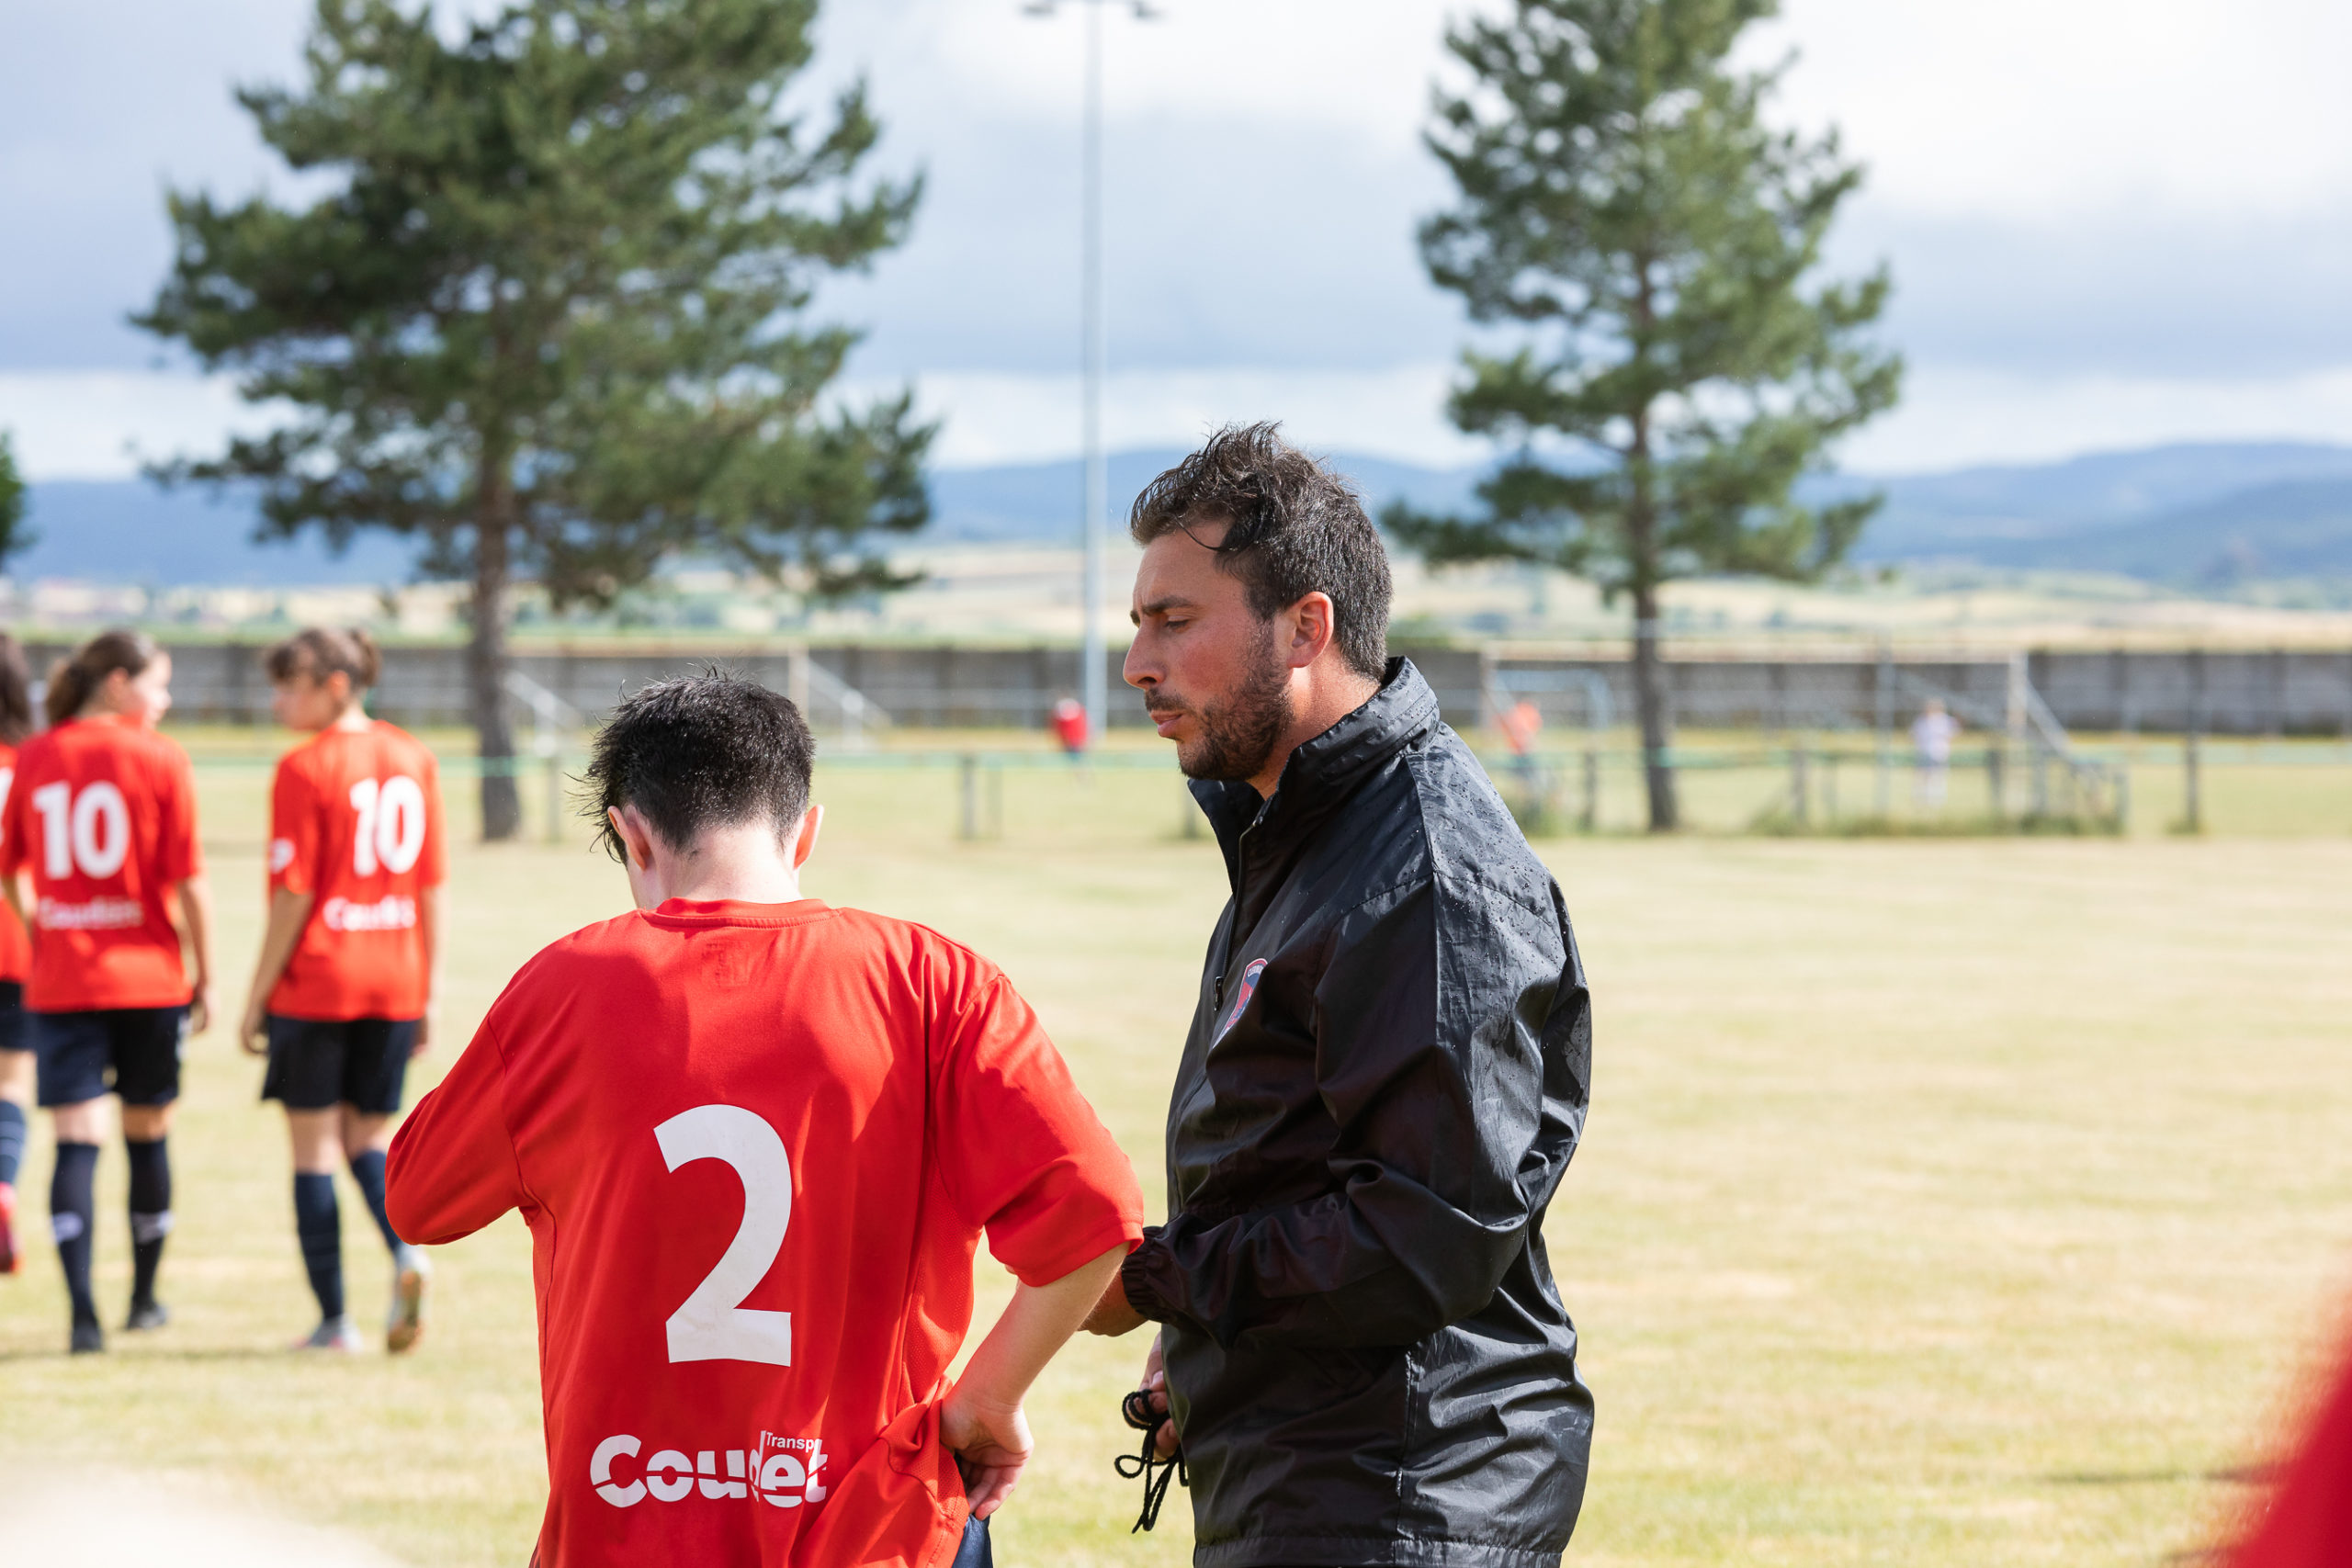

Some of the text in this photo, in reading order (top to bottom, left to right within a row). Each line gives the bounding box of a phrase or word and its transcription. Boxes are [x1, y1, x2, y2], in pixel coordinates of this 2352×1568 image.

[32, 780, 130, 879] 10
[349, 775, 425, 876] 10
[653, 1104, 792, 1367] 2
